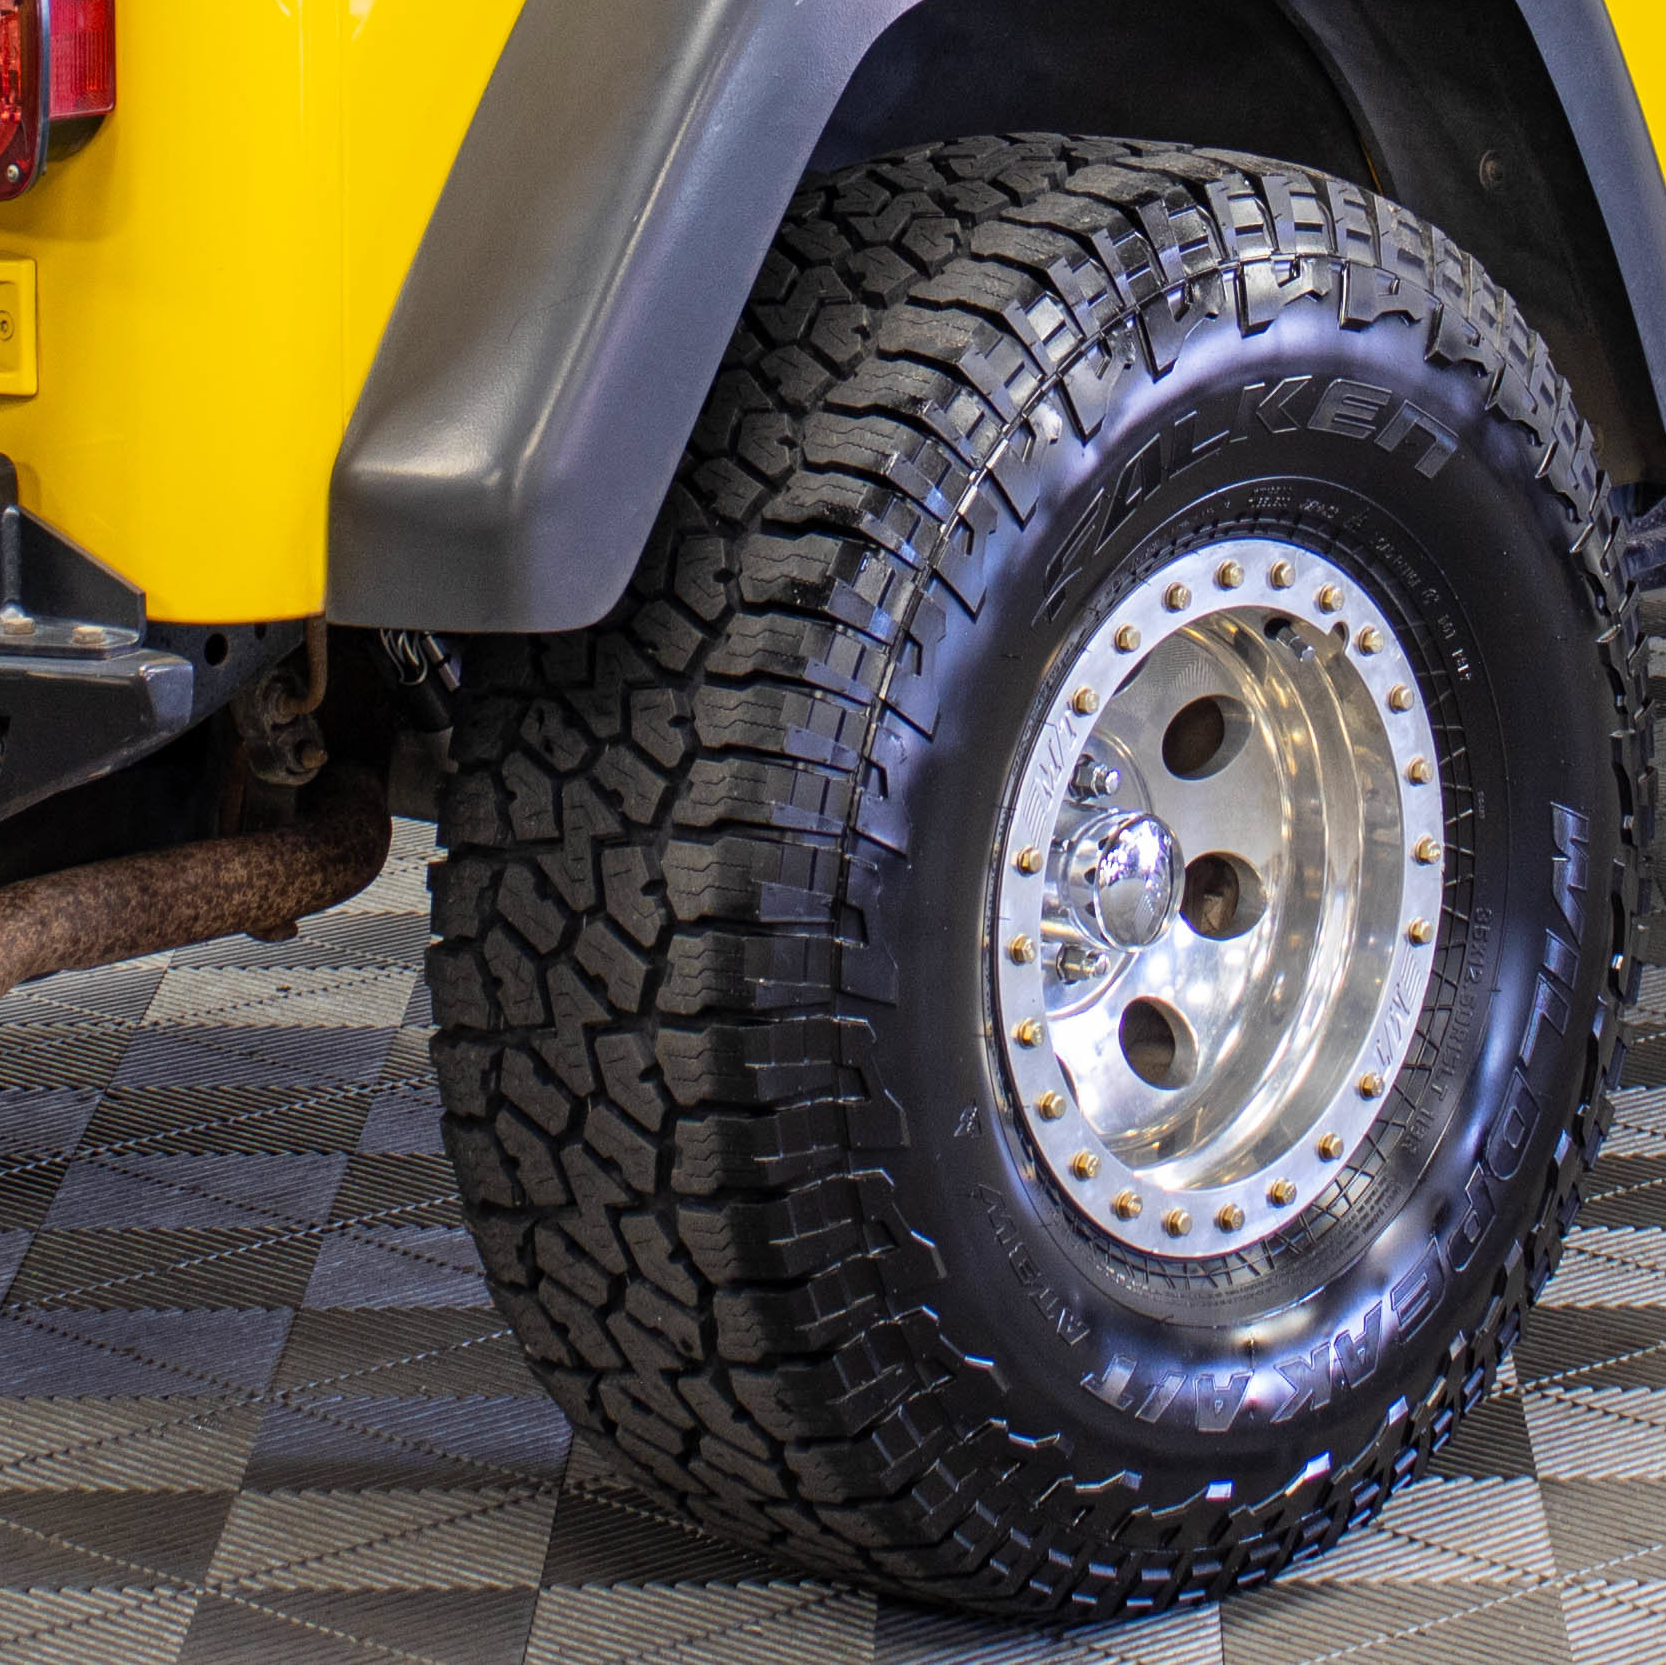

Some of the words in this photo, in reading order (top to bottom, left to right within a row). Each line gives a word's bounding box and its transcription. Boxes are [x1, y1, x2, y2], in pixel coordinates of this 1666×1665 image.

[1032, 374, 1462, 628] FALKEN
[1269, 801, 1593, 1427] WILDPEAK
[1082, 1352, 1253, 1434] A/T
